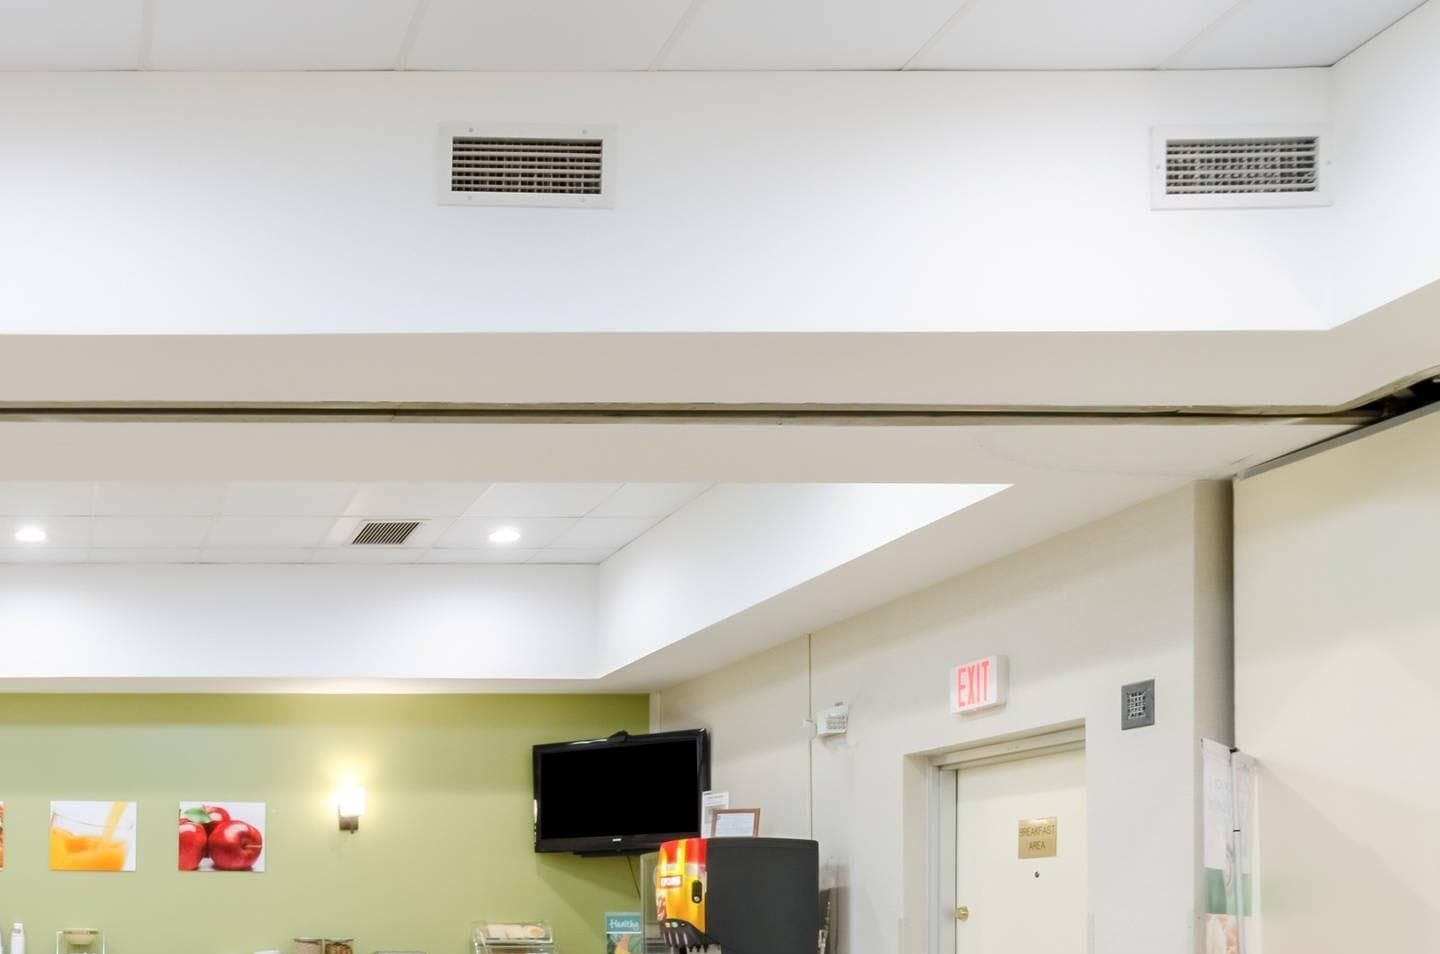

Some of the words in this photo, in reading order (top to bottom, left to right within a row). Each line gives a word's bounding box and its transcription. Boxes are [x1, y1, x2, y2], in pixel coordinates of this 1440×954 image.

[957, 660, 990, 708] EXIT
[1018, 824, 1056, 837] BREAKFAST
[1029, 840, 1046, 850] AREA
